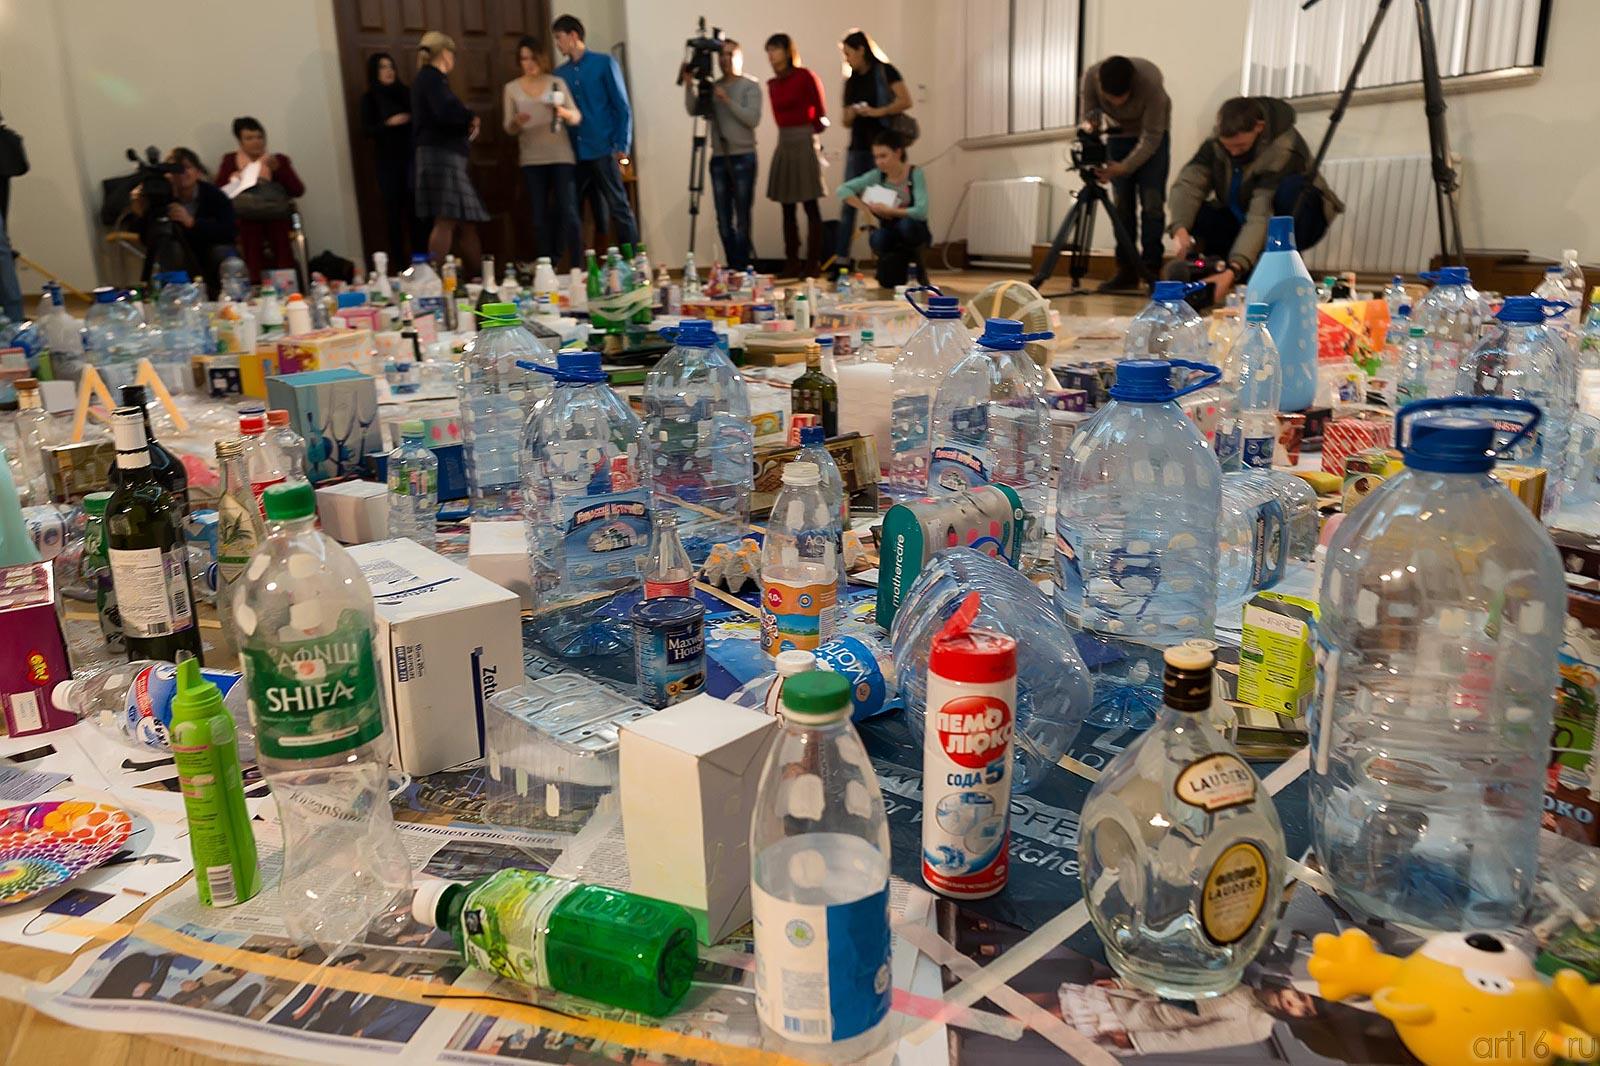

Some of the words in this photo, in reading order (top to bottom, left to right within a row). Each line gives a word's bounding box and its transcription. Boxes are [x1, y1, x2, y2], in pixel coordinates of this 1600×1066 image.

[892, 534, 905, 608] mothercare
[266, 679, 356, 712] SHIFA
[936, 706, 1003, 734] ПЕМО
[946, 772, 983, 788] СОДА
[985, 757, 1005, 785] 5
